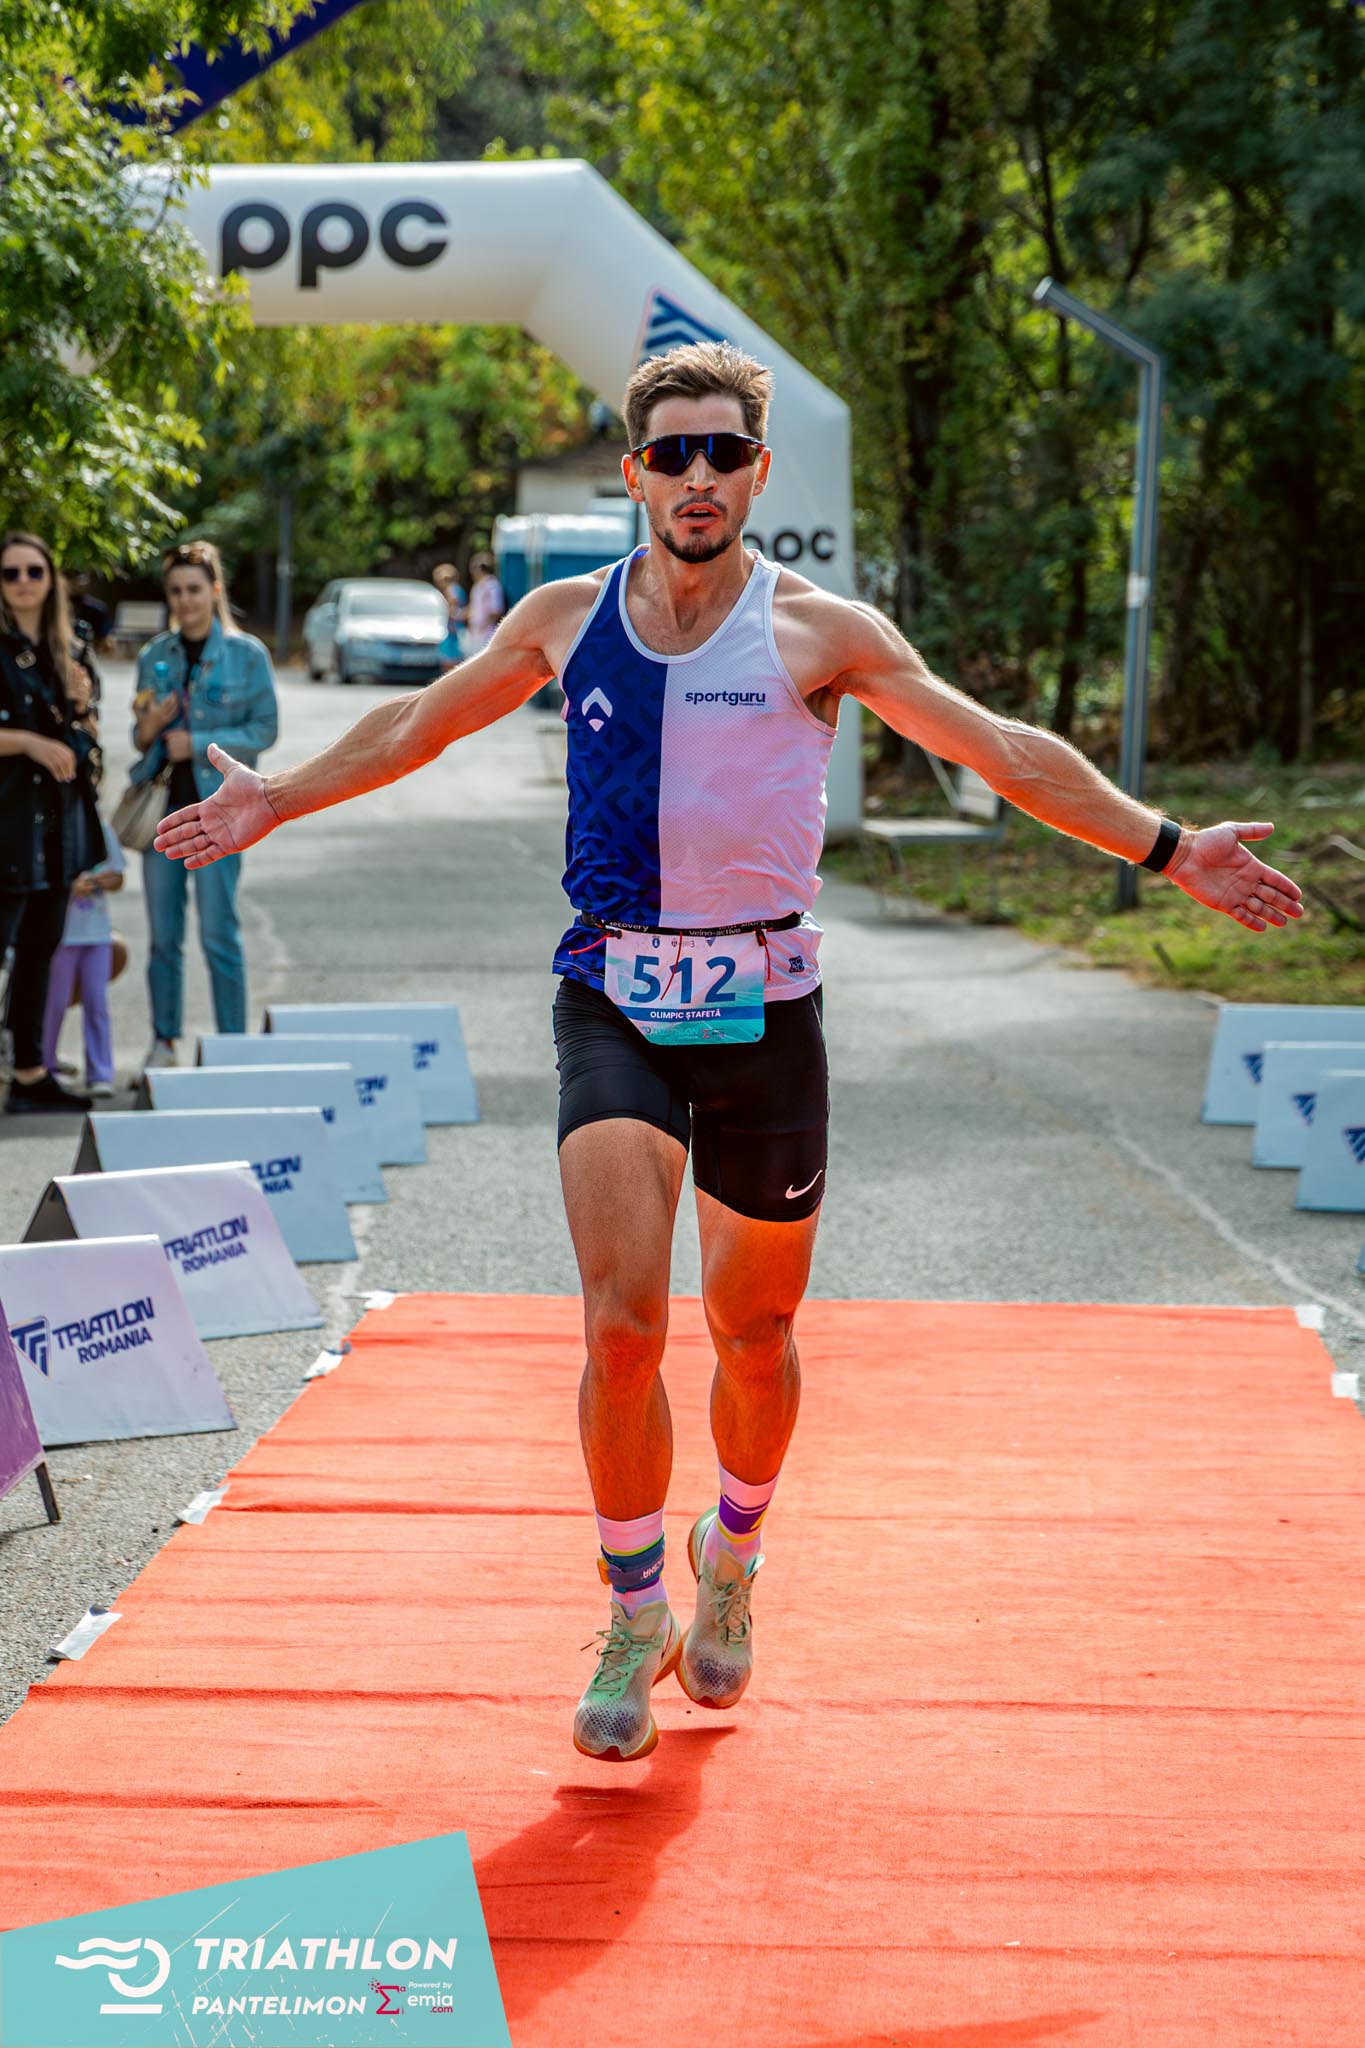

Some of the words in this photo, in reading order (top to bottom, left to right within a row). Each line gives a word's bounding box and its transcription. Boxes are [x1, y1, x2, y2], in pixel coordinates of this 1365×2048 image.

[221, 201, 449, 288] ppc
[685, 691, 765, 706] sportguru
[610, 921, 648, 932] recovery
[629, 955, 736, 1003] 512
[650, 1011, 684, 1019] OLIMPIC
[164, 1215, 248, 1261] TRIATLON
[181, 1242, 247, 1274] ROMANIA
[52, 1297, 154, 1350] TRIATLON
[77, 1327, 153, 1364] ROMANIA
